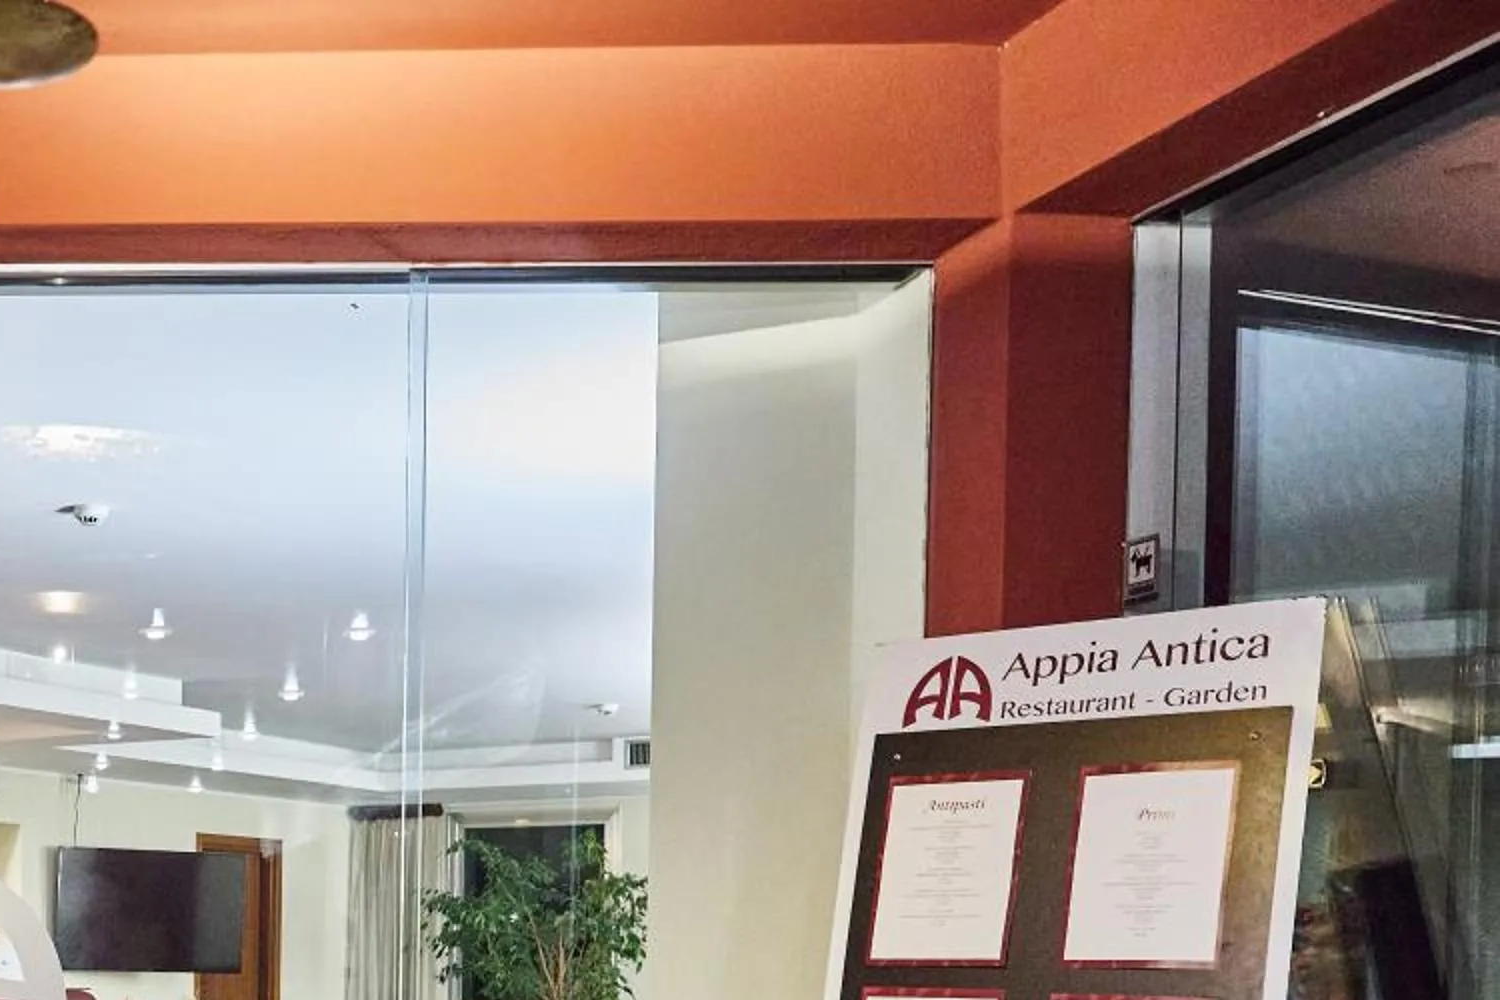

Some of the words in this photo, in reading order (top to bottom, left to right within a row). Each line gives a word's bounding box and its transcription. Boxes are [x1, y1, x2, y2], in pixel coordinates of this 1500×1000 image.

[1001, 641, 1118, 687] Appia
[1132, 627, 1270, 671] Antica
[1000, 691, 1136, 719] Restaurant
[1163, 681, 1268, 708] Garden
